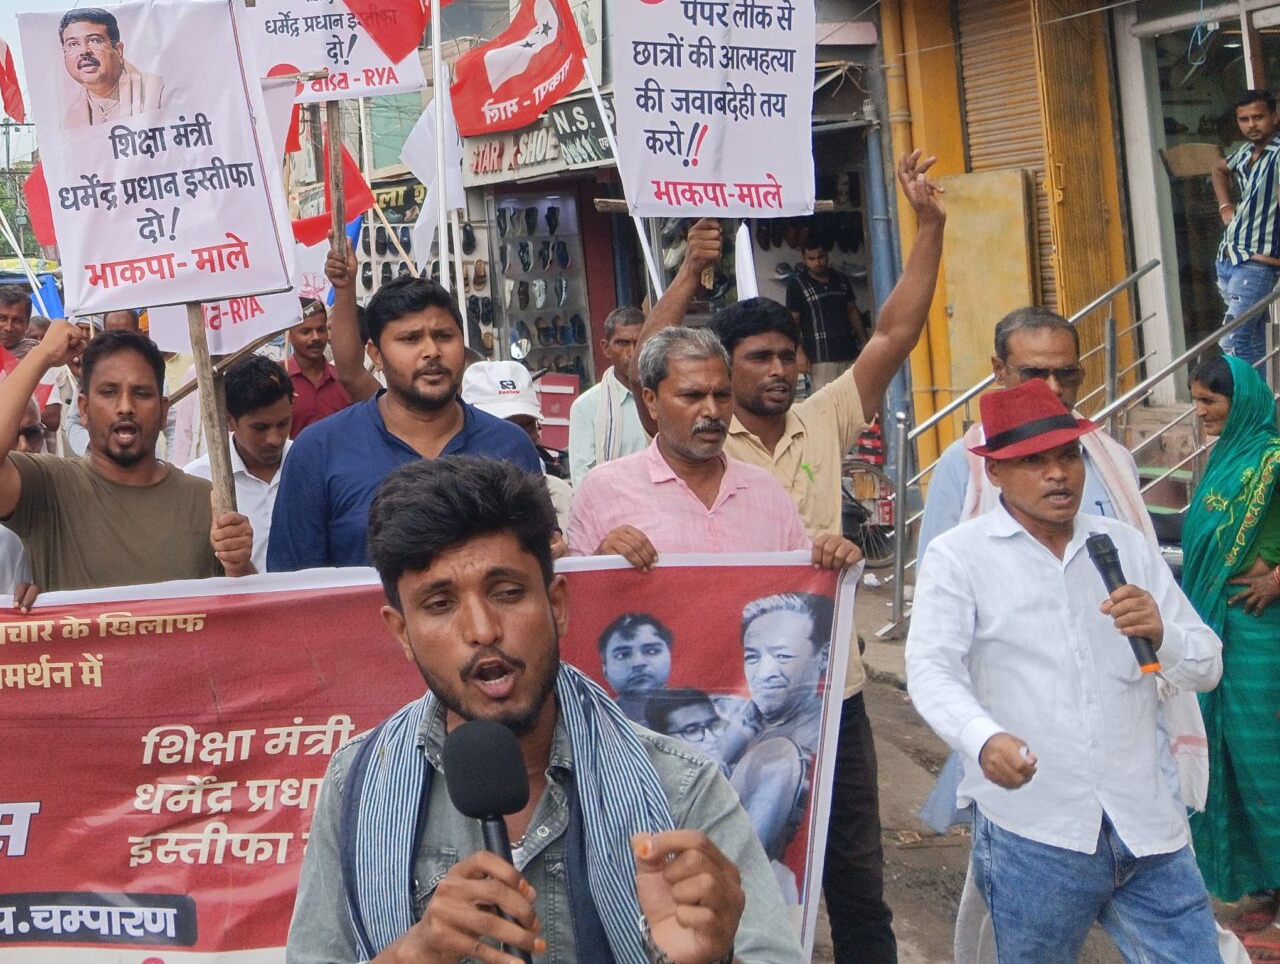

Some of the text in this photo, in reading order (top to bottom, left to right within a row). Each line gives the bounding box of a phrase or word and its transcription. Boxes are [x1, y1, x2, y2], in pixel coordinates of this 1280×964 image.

[302, 11, 345, 34] प्रधान
[631, 32, 797, 76] छात्रों की आत्महत्या
[552, 106, 596, 135] N.S.
[634, 77, 666, 114] की
[669, 81, 757, 122] जवाबदेही
[759, 92, 788, 118] तय
[108, 112, 213, 160] शिक्षा मंत्री
[121, 171, 180, 205] प्रधान
[181, 156, 256, 199] इस्तीफा
[57, 615, 92, 636] के
[95, 611, 206, 636] खिलाफ
[78, 652, 104, 688] में
[141, 713, 356, 766] शिक्षा मंत्री
[244, 777, 324, 813] प्रधा
[127, 819, 294, 867] इस्तीफा
